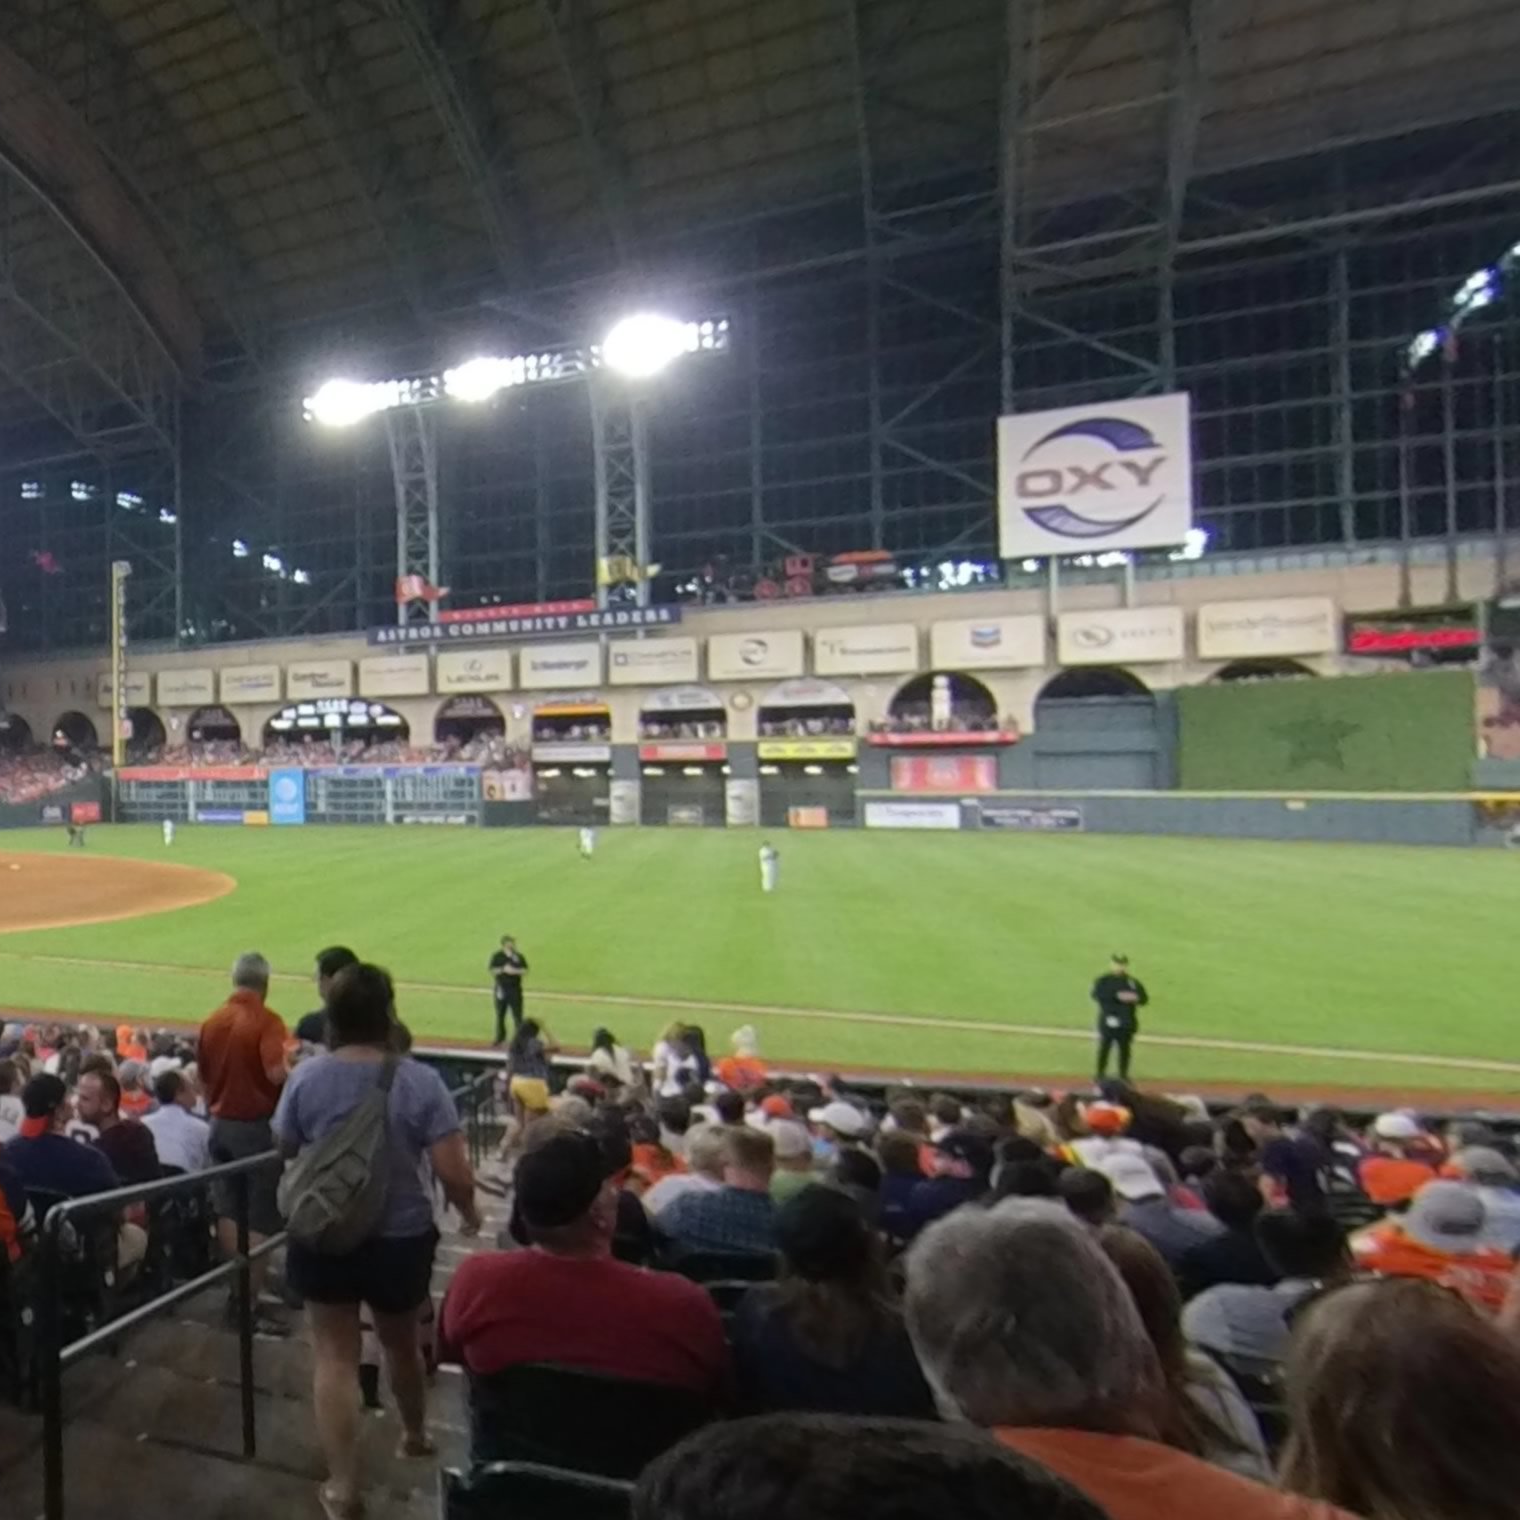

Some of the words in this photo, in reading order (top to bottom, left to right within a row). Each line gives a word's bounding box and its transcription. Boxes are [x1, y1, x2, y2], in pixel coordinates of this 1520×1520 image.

[1016, 456, 1167, 498] OXY
[377, 626, 443, 642] ASTROS
[448, 615, 568, 637] COMMUNITY
[576, 608, 670, 628] LEADERS
